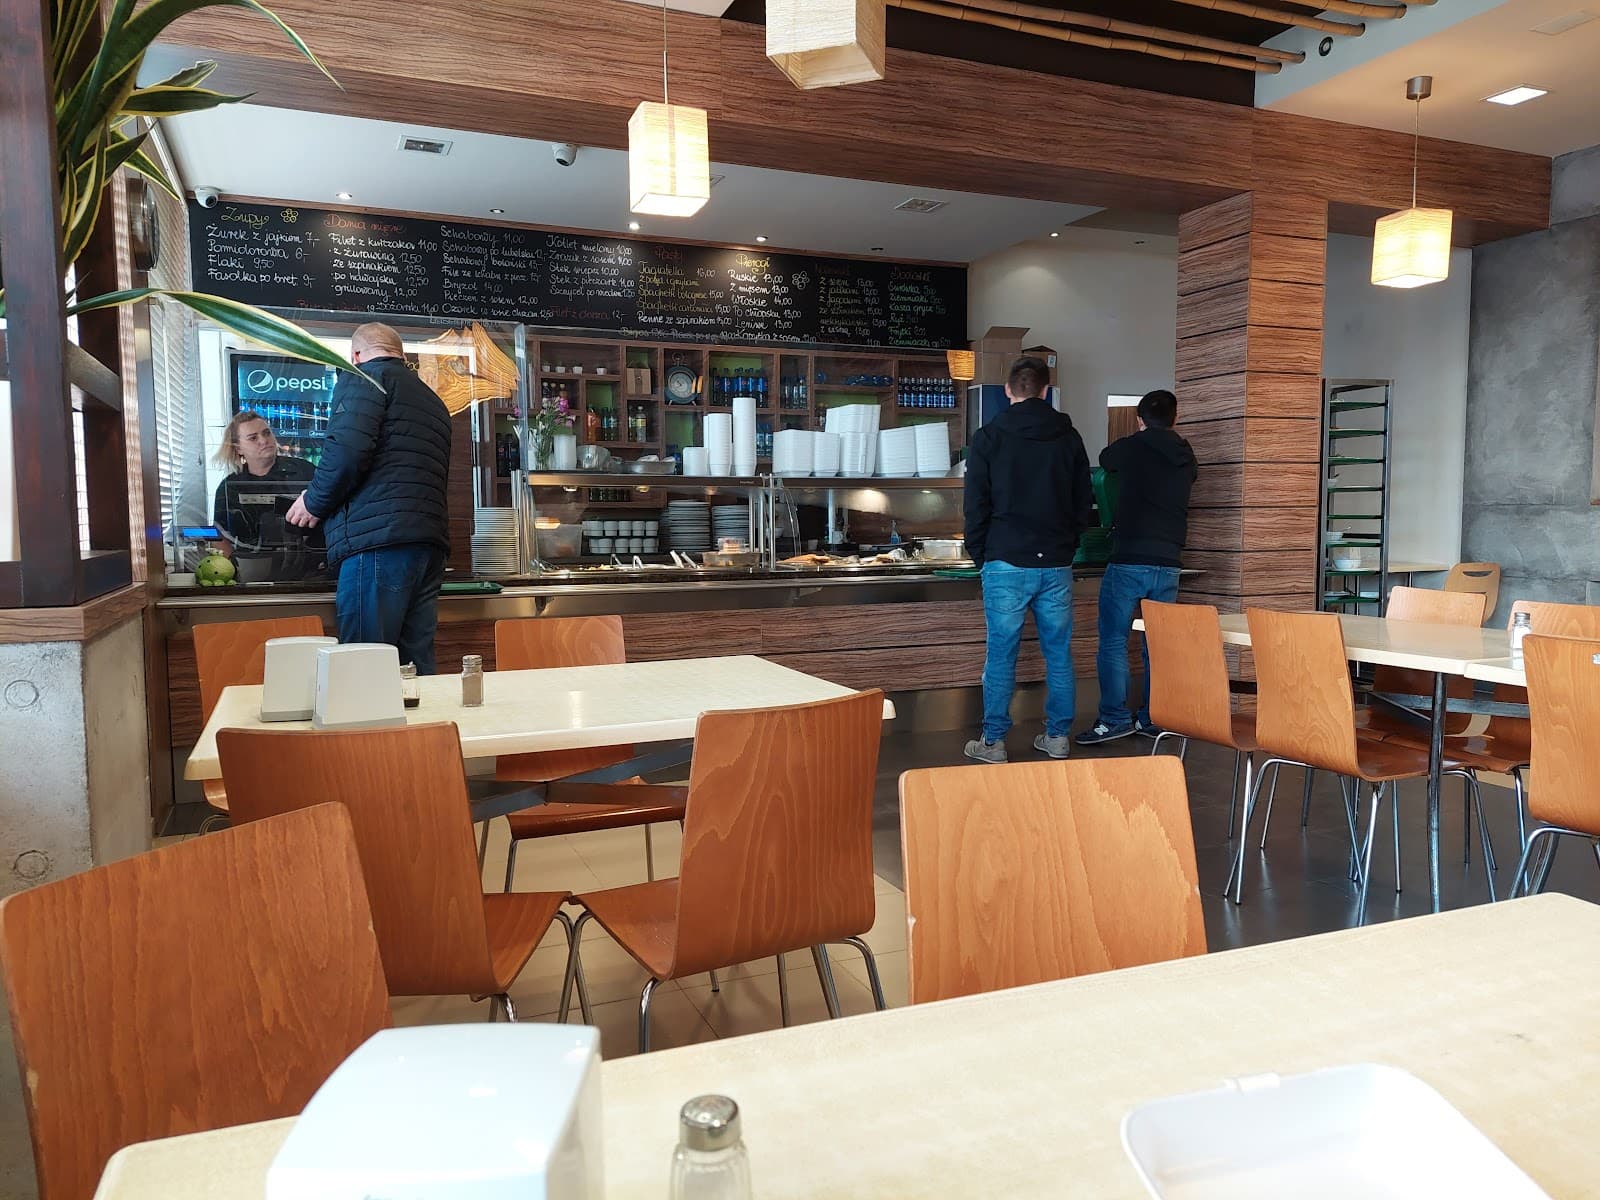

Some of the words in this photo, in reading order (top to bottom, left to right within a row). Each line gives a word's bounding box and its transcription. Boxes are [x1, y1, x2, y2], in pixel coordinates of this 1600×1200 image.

[221, 206, 270, 229] Zupy
[205, 223, 249, 240] Żurek
[252, 231, 261, 240] z
[264, 230, 303, 246] jajkiem
[328, 232, 357, 245] Filet
[358, 239, 365, 247] z
[441, 225, 496, 248] Schabowy
[546, 235, 577, 250] Kotlet
[207, 239, 289, 259] Pomidorowa
[442, 240, 487, 260] Schabowy
[207, 254, 245, 269] Flaki
[443, 253, 486, 272] Schabowy
[549, 262, 571, 274] Stek
[736, 253, 771, 275] Pierogi
[207, 268, 258, 283] Fasolka
[260, 274, 271, 289] po
[550, 274, 571, 284] Stek
[728, 269, 758, 283] Ruskie
[335, 284, 391, 302] grillowany
[638, 285, 676, 301] Spaghetti
[732, 294, 768, 307] Włoskie
[637, 311, 664, 324] Penne
[735, 318, 768, 329] Leniwe
[276, 376, 328, 392] pepsi
